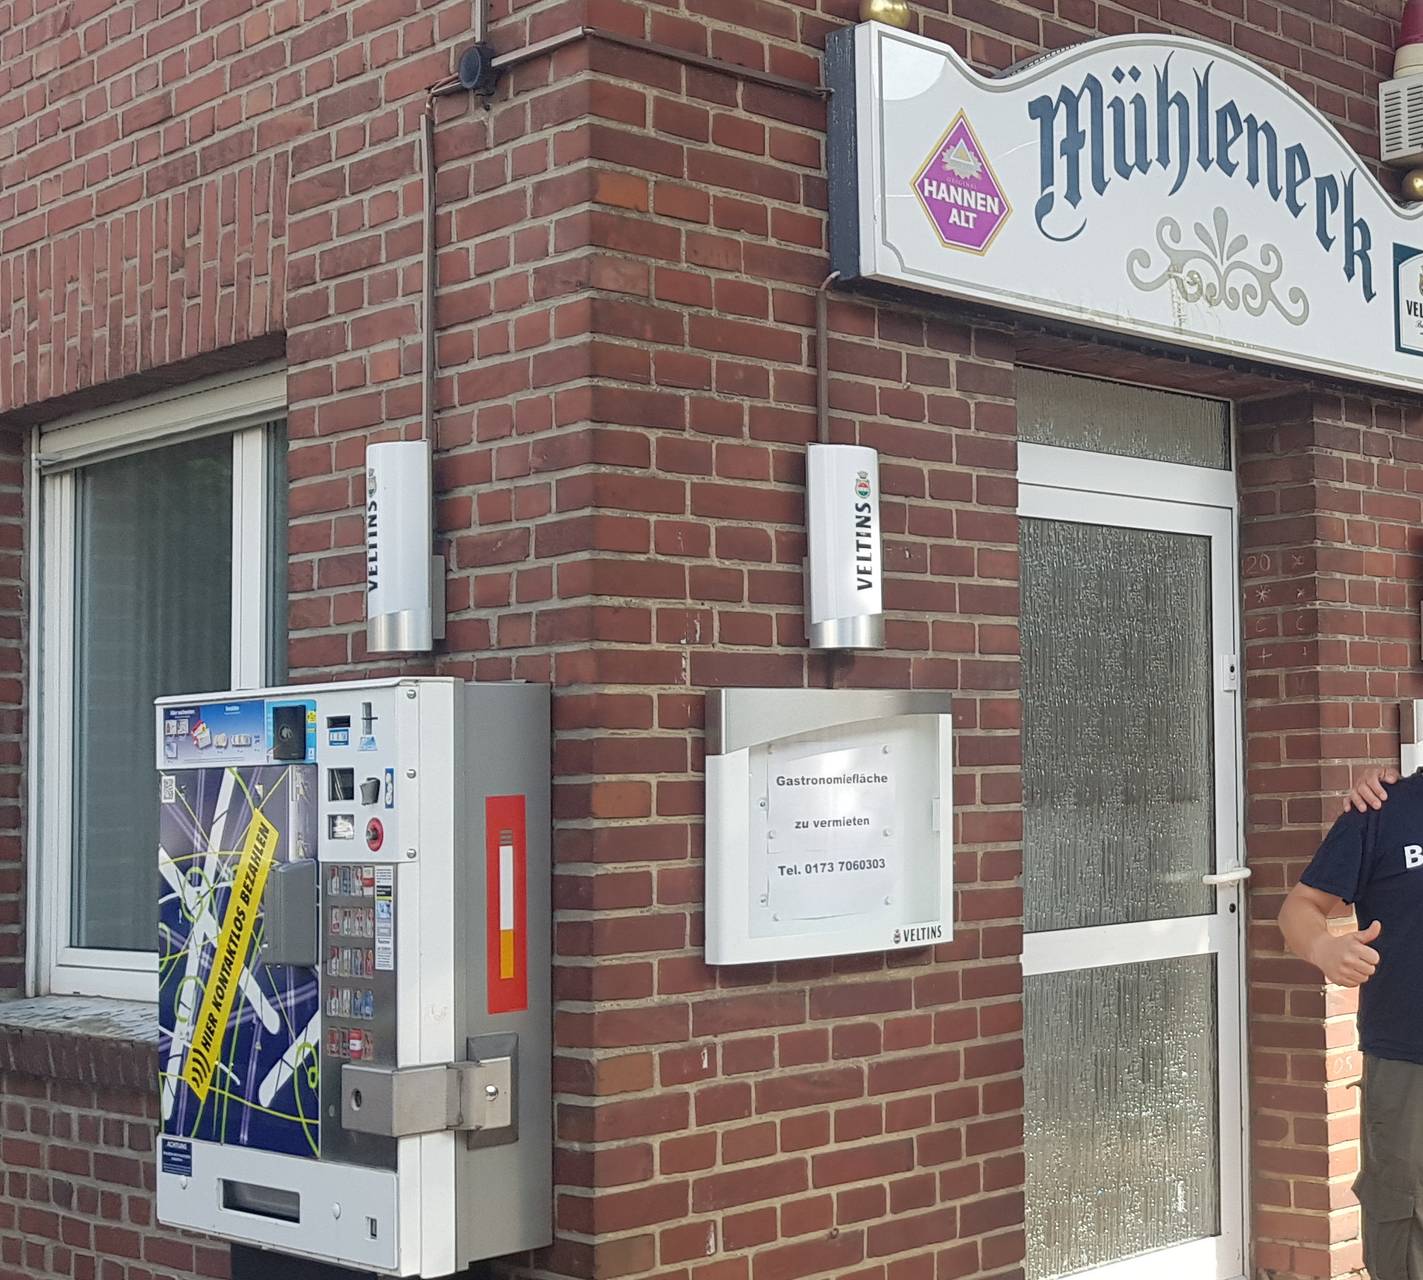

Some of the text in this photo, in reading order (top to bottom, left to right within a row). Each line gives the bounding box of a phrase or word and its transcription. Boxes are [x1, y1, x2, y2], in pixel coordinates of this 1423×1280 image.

[1028, 50, 1376, 304] Mühleneck
[923, 178, 1000, 215] HANNEN
[949, 207, 977, 229] ALT
[368, 500, 378, 593] VELTINS
[855, 502, 873, 591] VELTINS
[776, 772, 888, 786] Gastronomiefläche
[795, 816, 870, 829] zu vermieten
[778, 858, 886, 876] Tel. 0173 7060303
[201, 820, 271, 1053] HIER KONTAKTLOS BEZAHLEN
[903, 925, 942, 942] VELTINS
